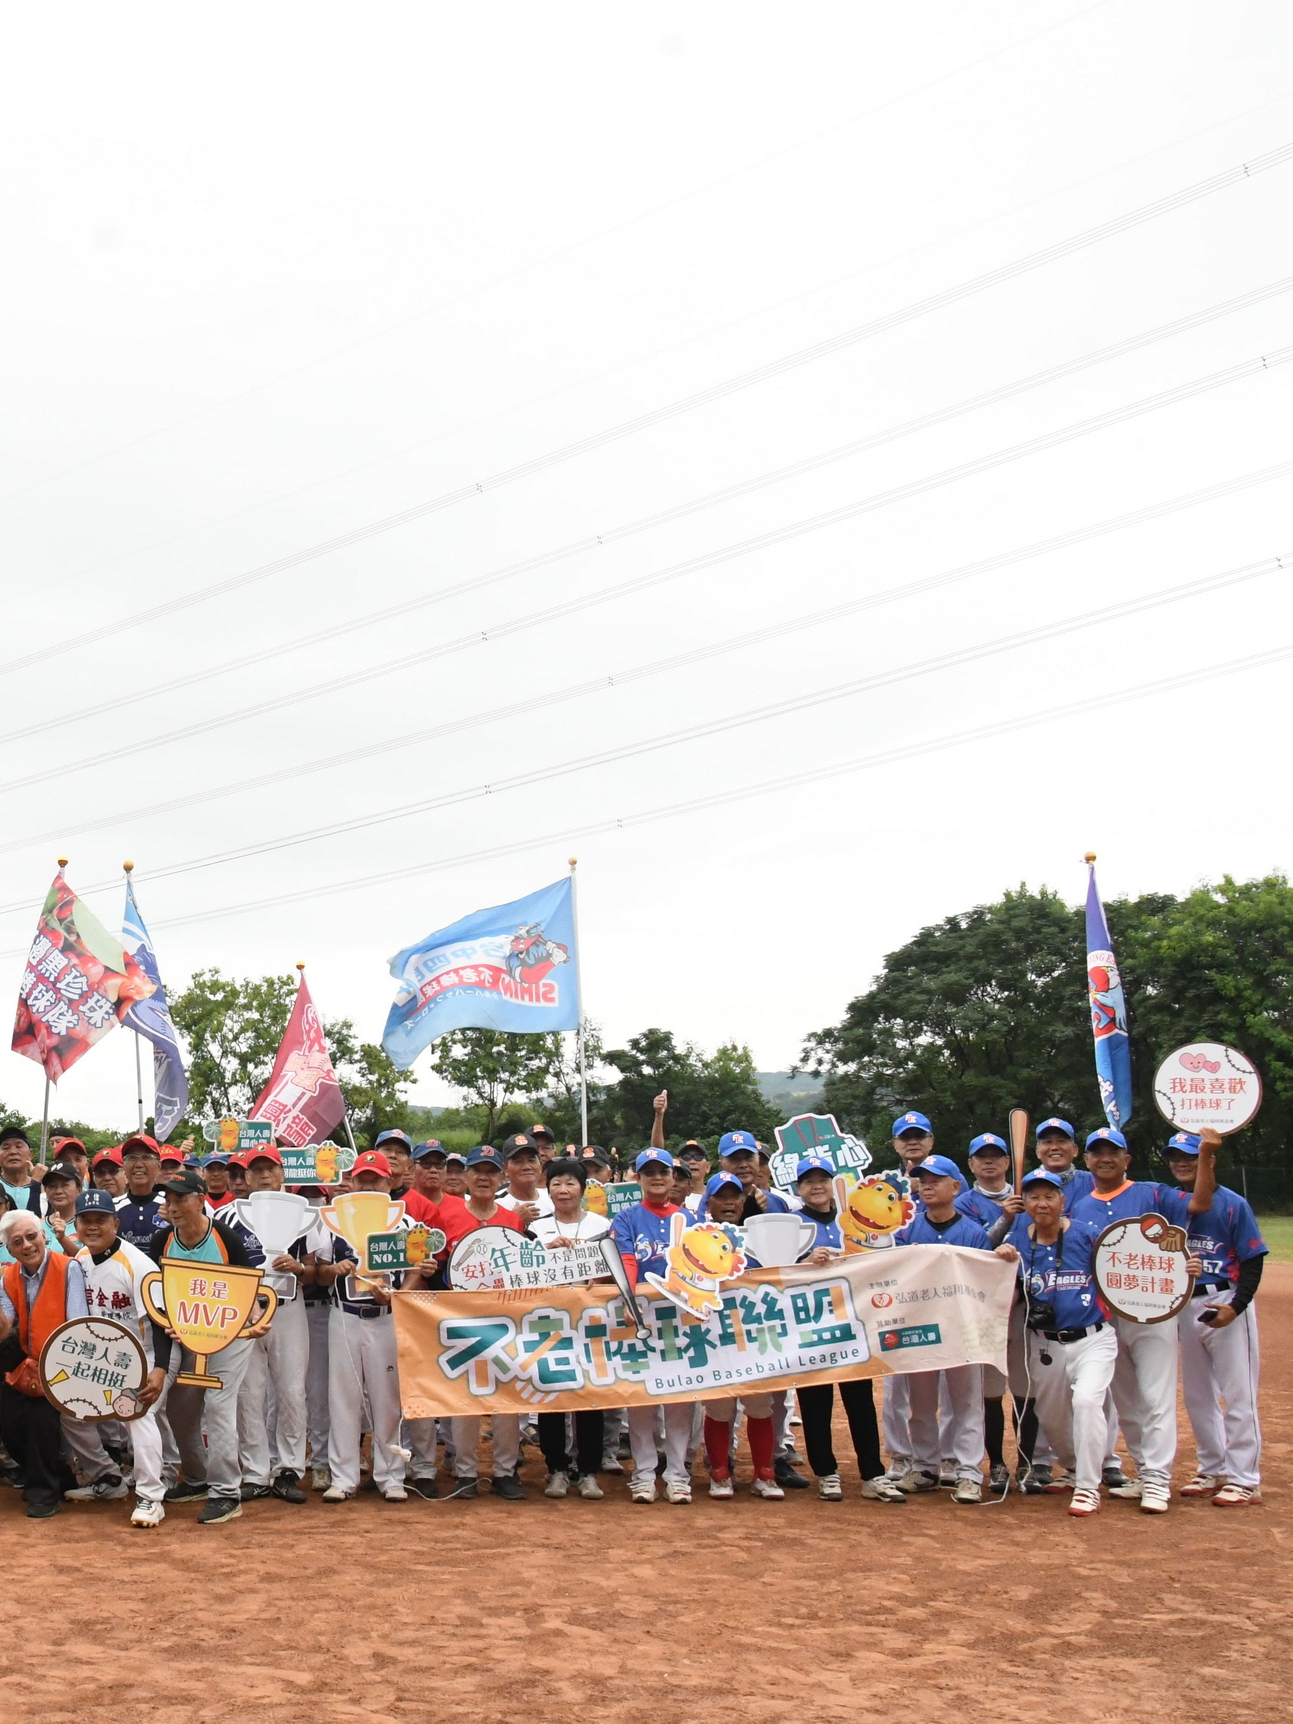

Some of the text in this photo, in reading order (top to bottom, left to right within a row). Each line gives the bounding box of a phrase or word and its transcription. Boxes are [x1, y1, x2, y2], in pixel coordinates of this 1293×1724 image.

[1169, 1077, 1247, 1095] 我最喜歡
[1180, 1098, 1236, 1111] 打棒球了
[490, 1240, 600, 1273] 年齡 不是問題
[1187, 1237, 1214, 1250] AGLES
[509, 1258, 610, 1290] 棒球沒有距離
[1106, 1251, 1175, 1274] 不老棒球
[189, 1278, 229, 1300] 我是
[1047, 1273, 1086, 1286] EAGLES
[1106, 1271, 1175, 1296] 圓夢計畫
[177, 1300, 239, 1329] MVP
[444, 1285, 857, 1389] 不老棒球聯盟
[60, 1335, 133, 1371] 台灣人壽
[55, 1360, 128, 1391] 一起相挺
[655, 1347, 860, 1389] Bulao Baseball League
